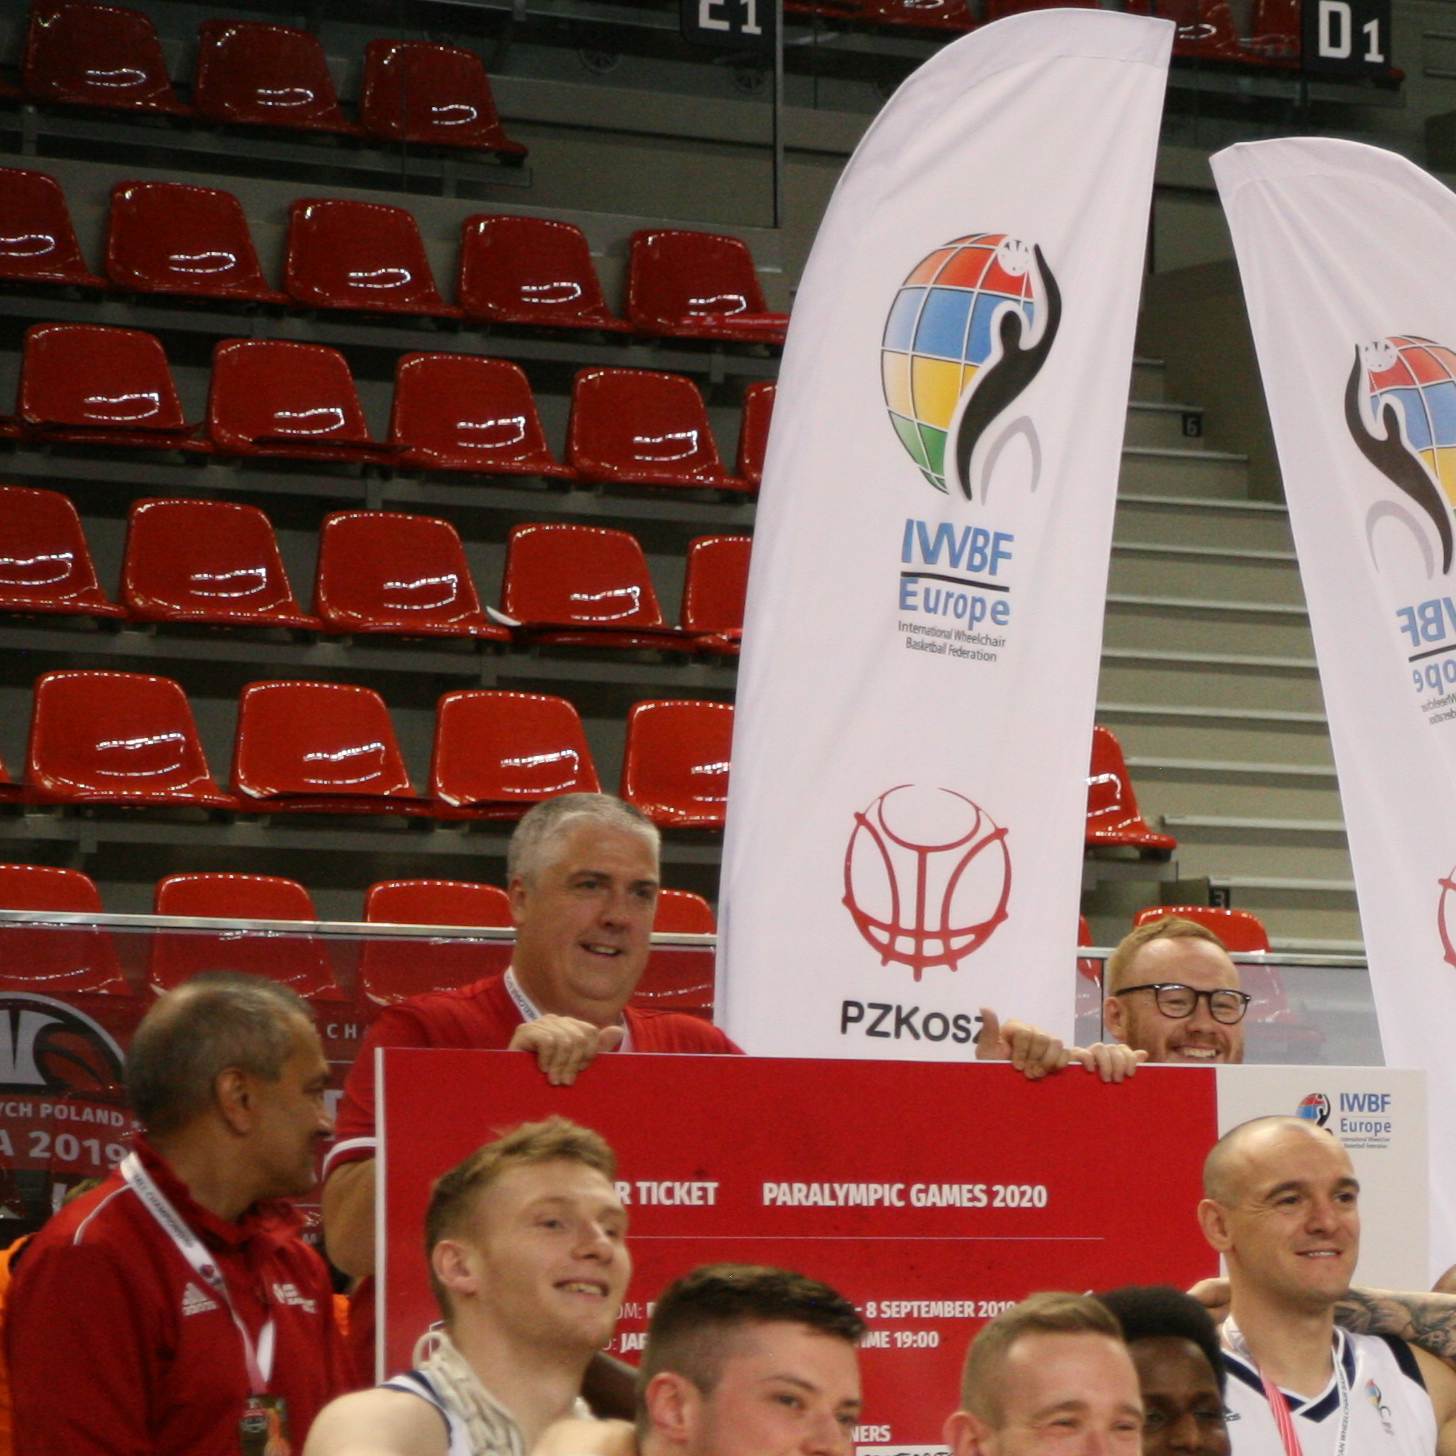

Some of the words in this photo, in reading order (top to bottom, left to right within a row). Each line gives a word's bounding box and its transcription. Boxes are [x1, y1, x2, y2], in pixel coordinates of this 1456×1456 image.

[1318, 0, 1385, 63] D1
[901, 518, 1015, 576] IWBF
[898, 577, 1011, 631] Europe
[898, 620, 952, 640] International
[953, 629, 1006, 648] Wheelchair
[905, 636, 947, 655] Basketball
[948, 644, 998, 663] Federation
[40, 1102, 125, 1128] POLAND
[1340, 1093, 1391, 1113] IWBF
[1340, 1117, 1392, 1137] Europe
[28, 1130, 130, 1170] 2019
[636, 1181, 719, 1206] TICKET
[762, 1181, 905, 1208] PARALYMPIC
[910, 1183, 988, 1208] GAMES
[992, 1184, 1048, 1208] 2020
[865, 1301, 878, 1318] 8
[880, 1301, 976, 1318] SEPTEMBER
[860, 1331, 890, 1348] IME
[894, 1331, 940, 1348] 19:00
[851, 1424, 892, 1442] NERS
